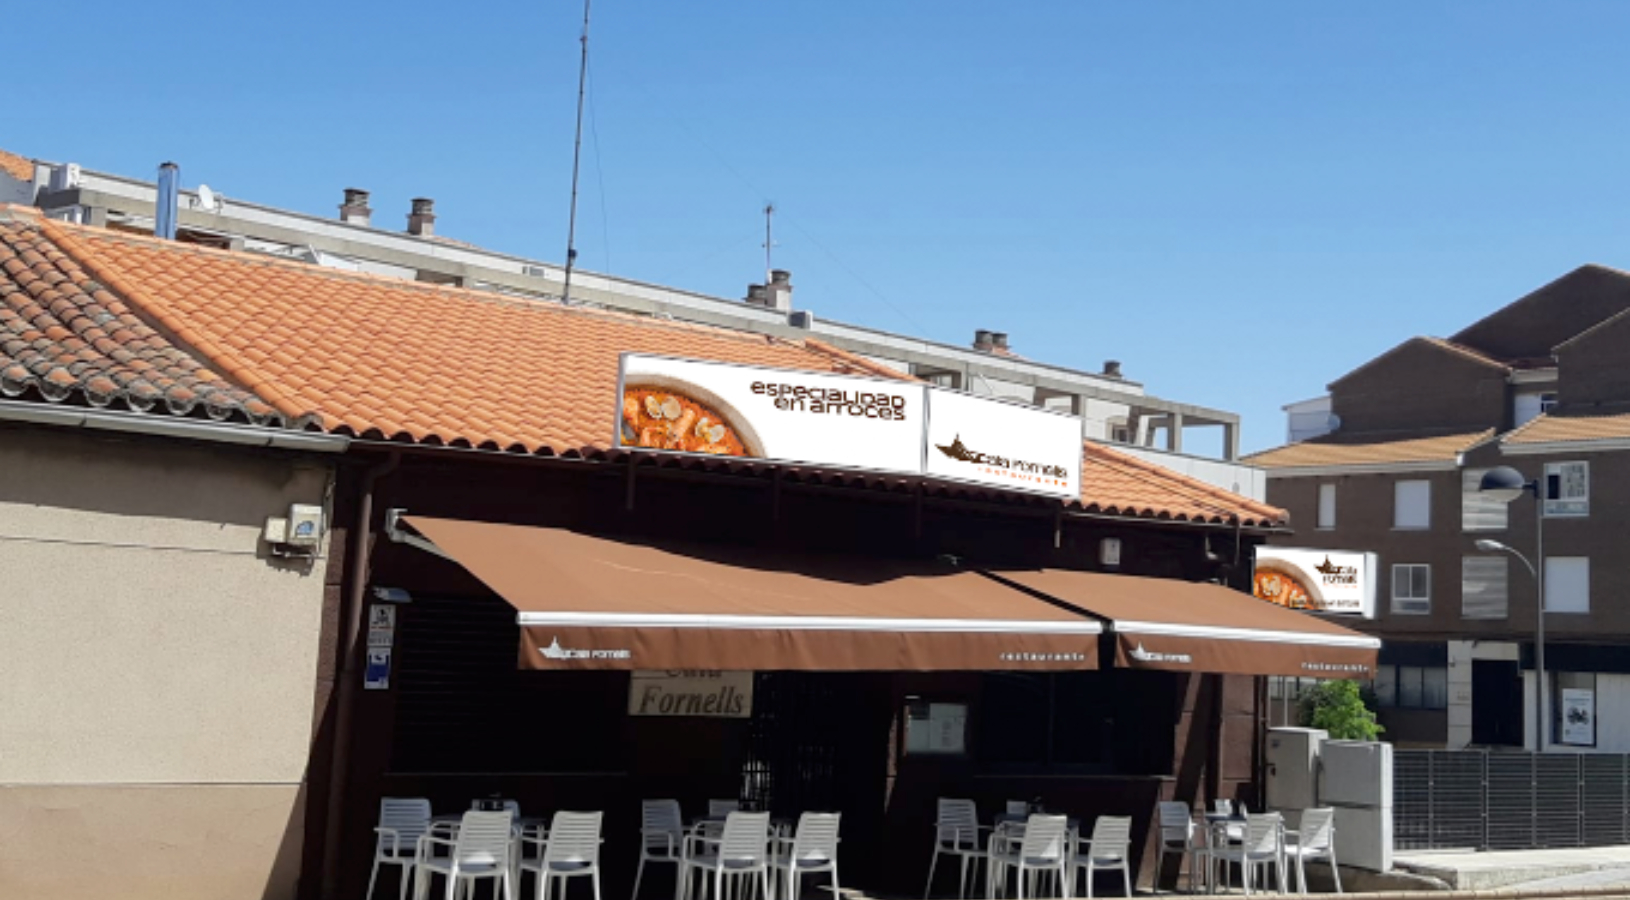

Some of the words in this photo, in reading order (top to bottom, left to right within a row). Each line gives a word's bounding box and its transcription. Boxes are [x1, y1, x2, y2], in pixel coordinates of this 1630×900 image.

[774, 396, 806, 411] en
[809, 396, 906, 421] arroces
[638, 685, 744, 714] Fornells
